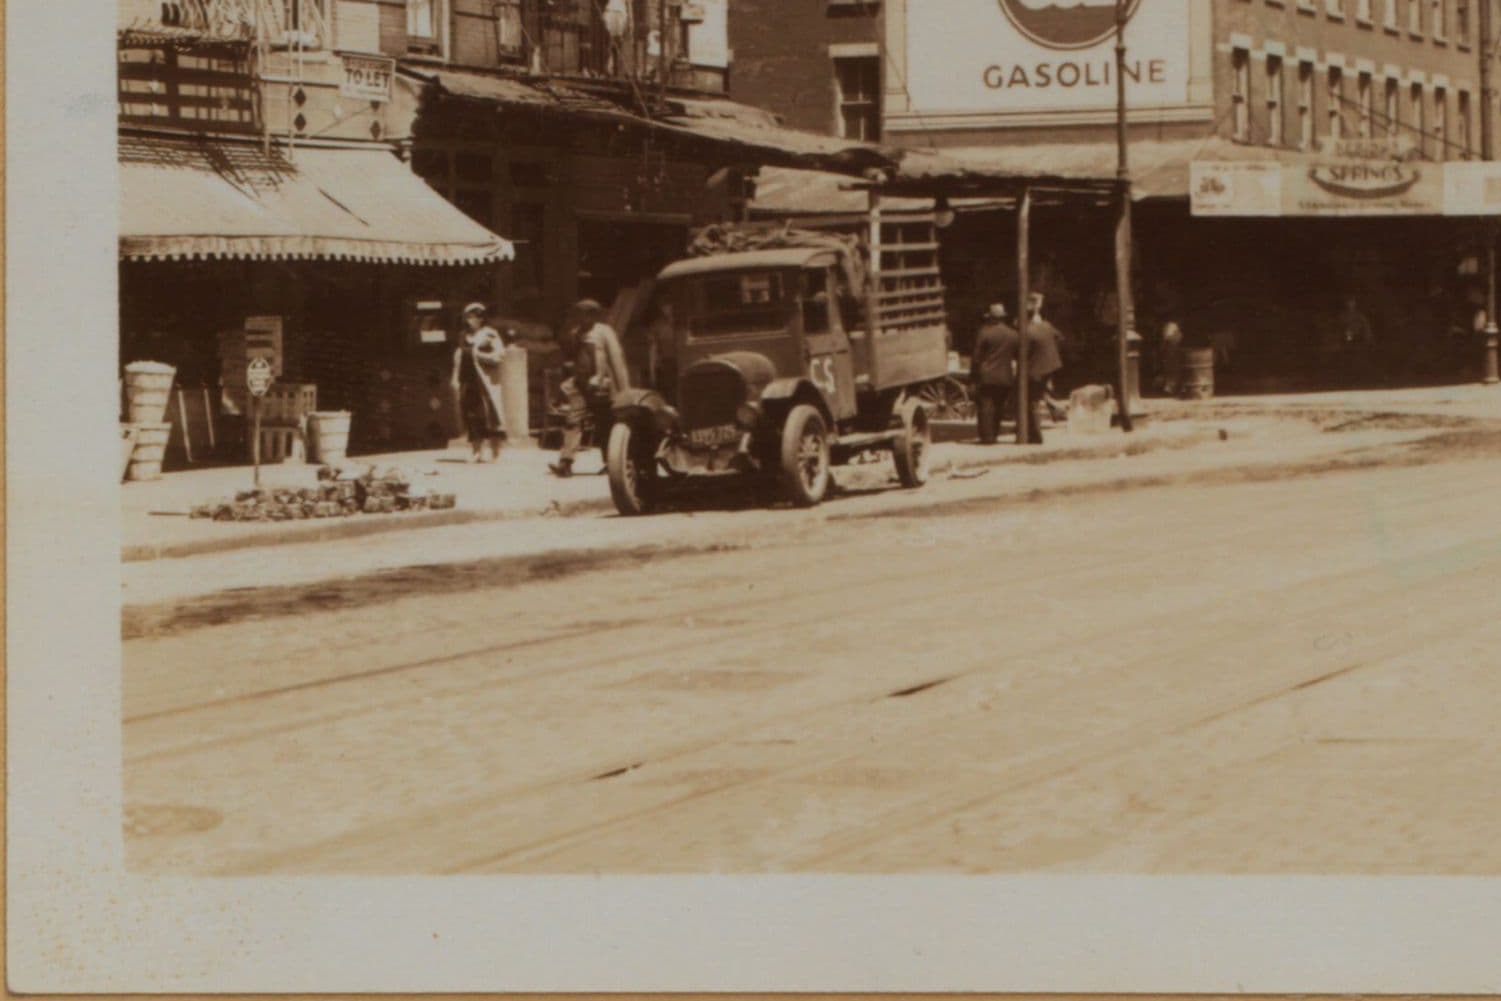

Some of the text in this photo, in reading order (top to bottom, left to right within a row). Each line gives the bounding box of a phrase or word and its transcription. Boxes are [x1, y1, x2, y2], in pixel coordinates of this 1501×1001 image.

[345, 68, 390, 88] TO LET
[982, 59, 1167, 90] GASOLINE
